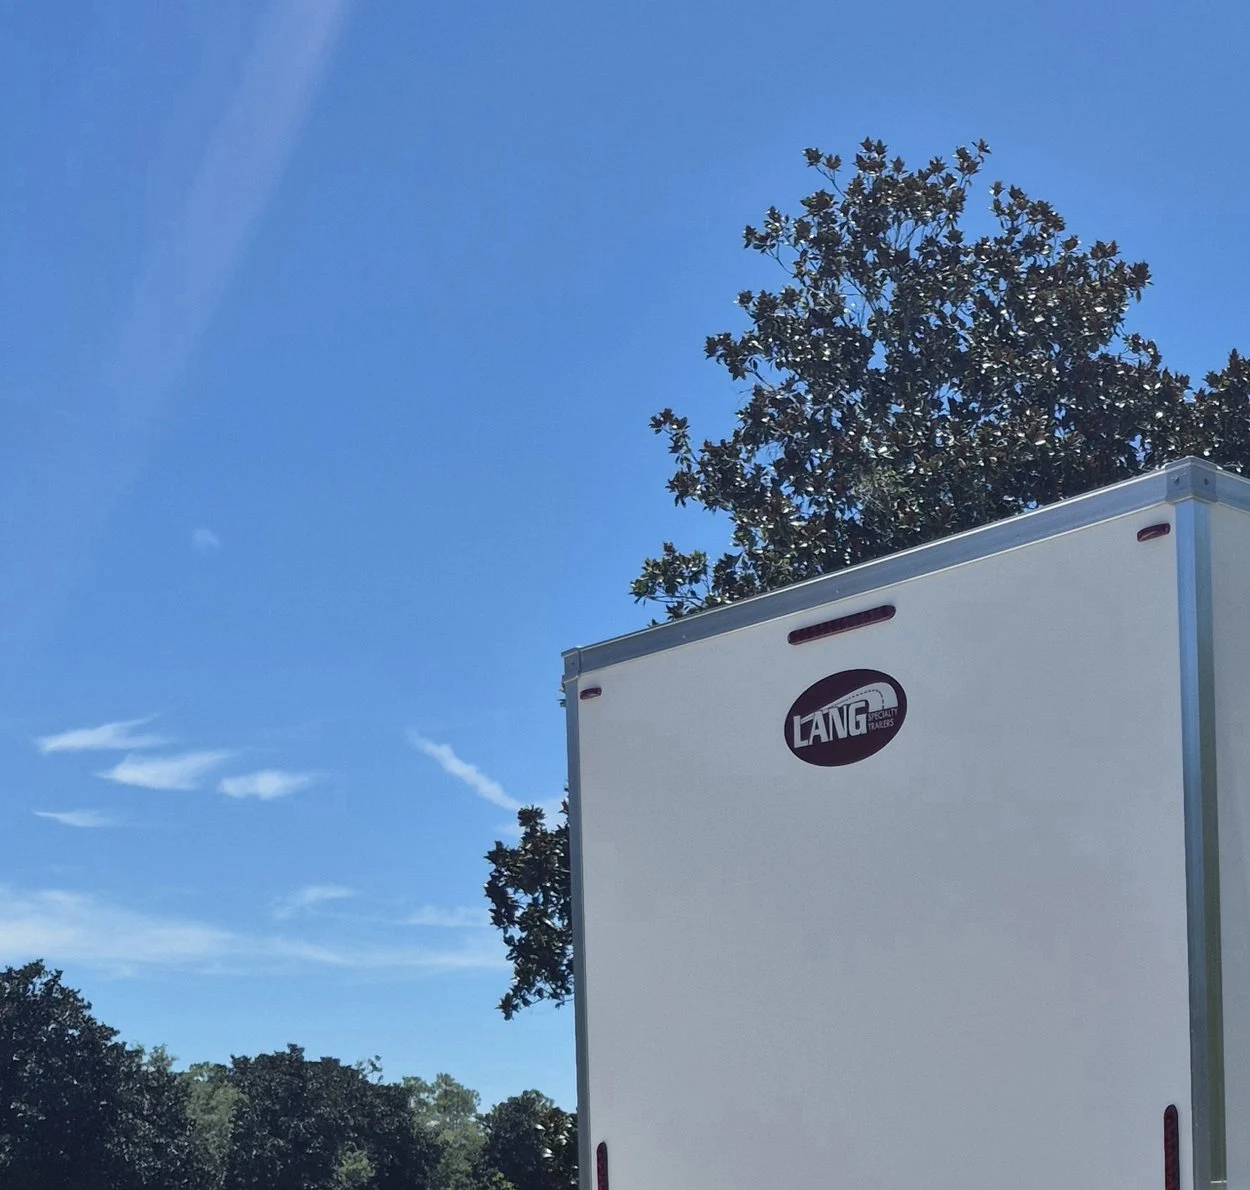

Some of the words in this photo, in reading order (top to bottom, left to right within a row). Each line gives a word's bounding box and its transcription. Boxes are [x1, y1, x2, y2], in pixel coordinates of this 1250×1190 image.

[867, 707, 899, 722] SPECIALTY
[793, 699, 868, 749] LANG
[868, 718, 895, 731] TRAILERS
